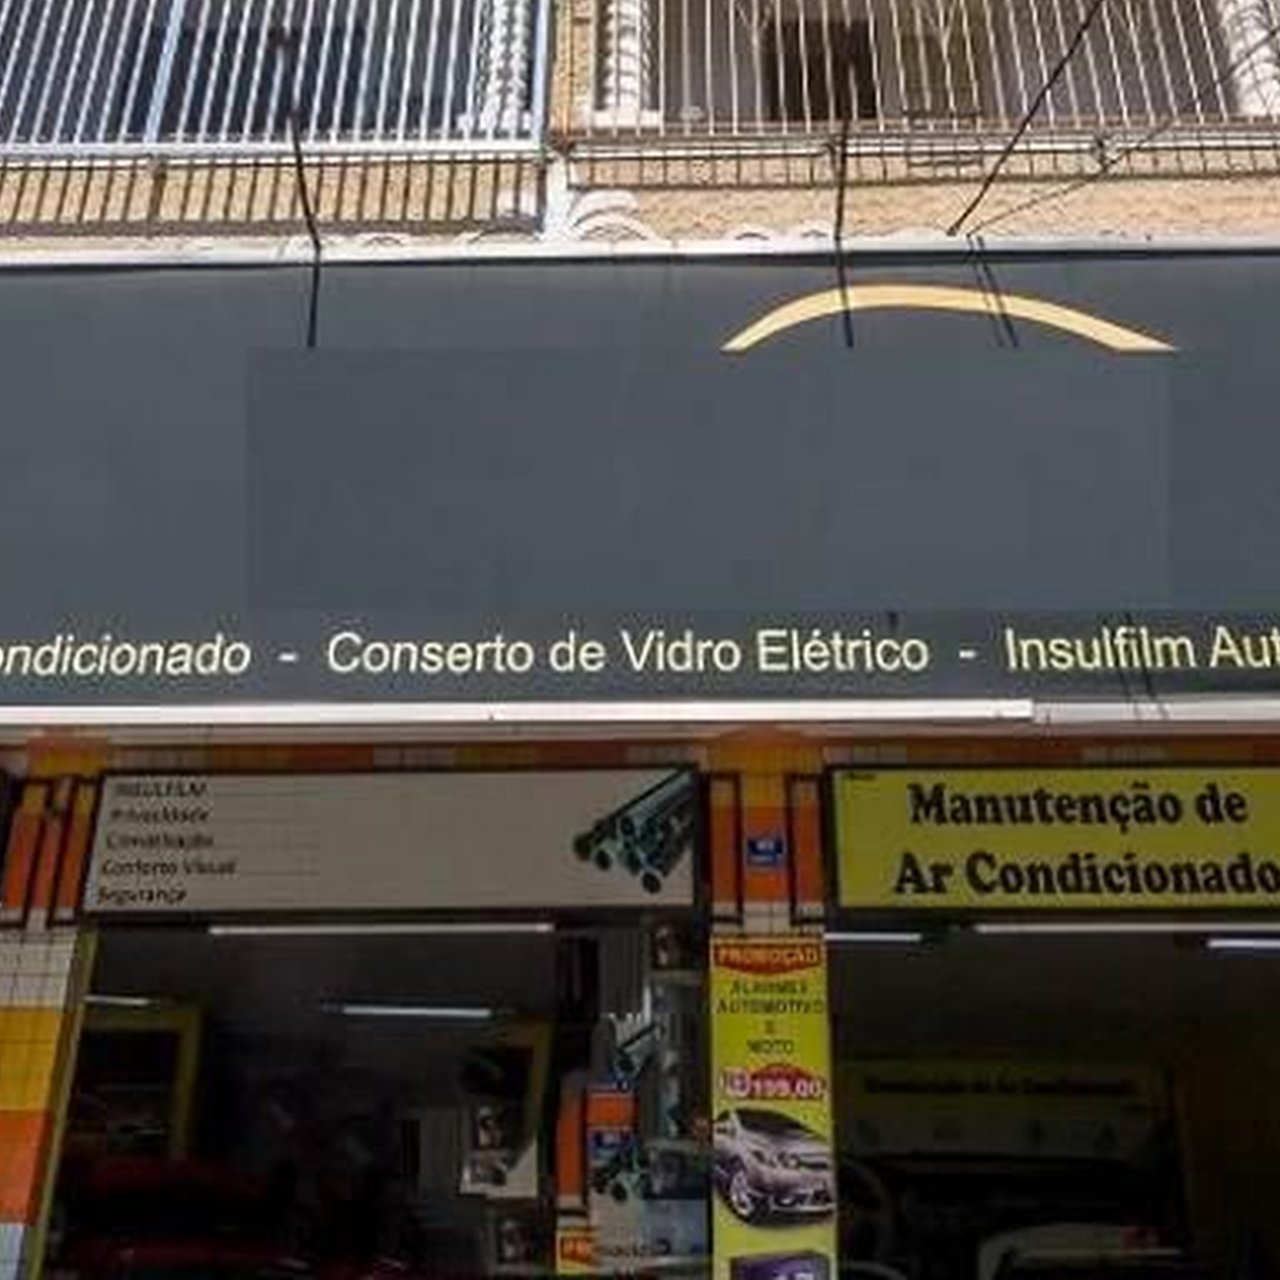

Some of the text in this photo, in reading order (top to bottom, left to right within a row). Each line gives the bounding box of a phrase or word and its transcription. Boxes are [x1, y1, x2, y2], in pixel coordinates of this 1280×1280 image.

[326, 631, 535, 674] Conserto
[549, 630, 606, 672] de
[620, 629, 742, 672] Vidro
[756, 628, 929, 672] Elétrico
[1005, 625, 1198, 671] Insulfilm
[907, 781, 1248, 834] Manutenção de
[894, 852, 953, 894] Ar
